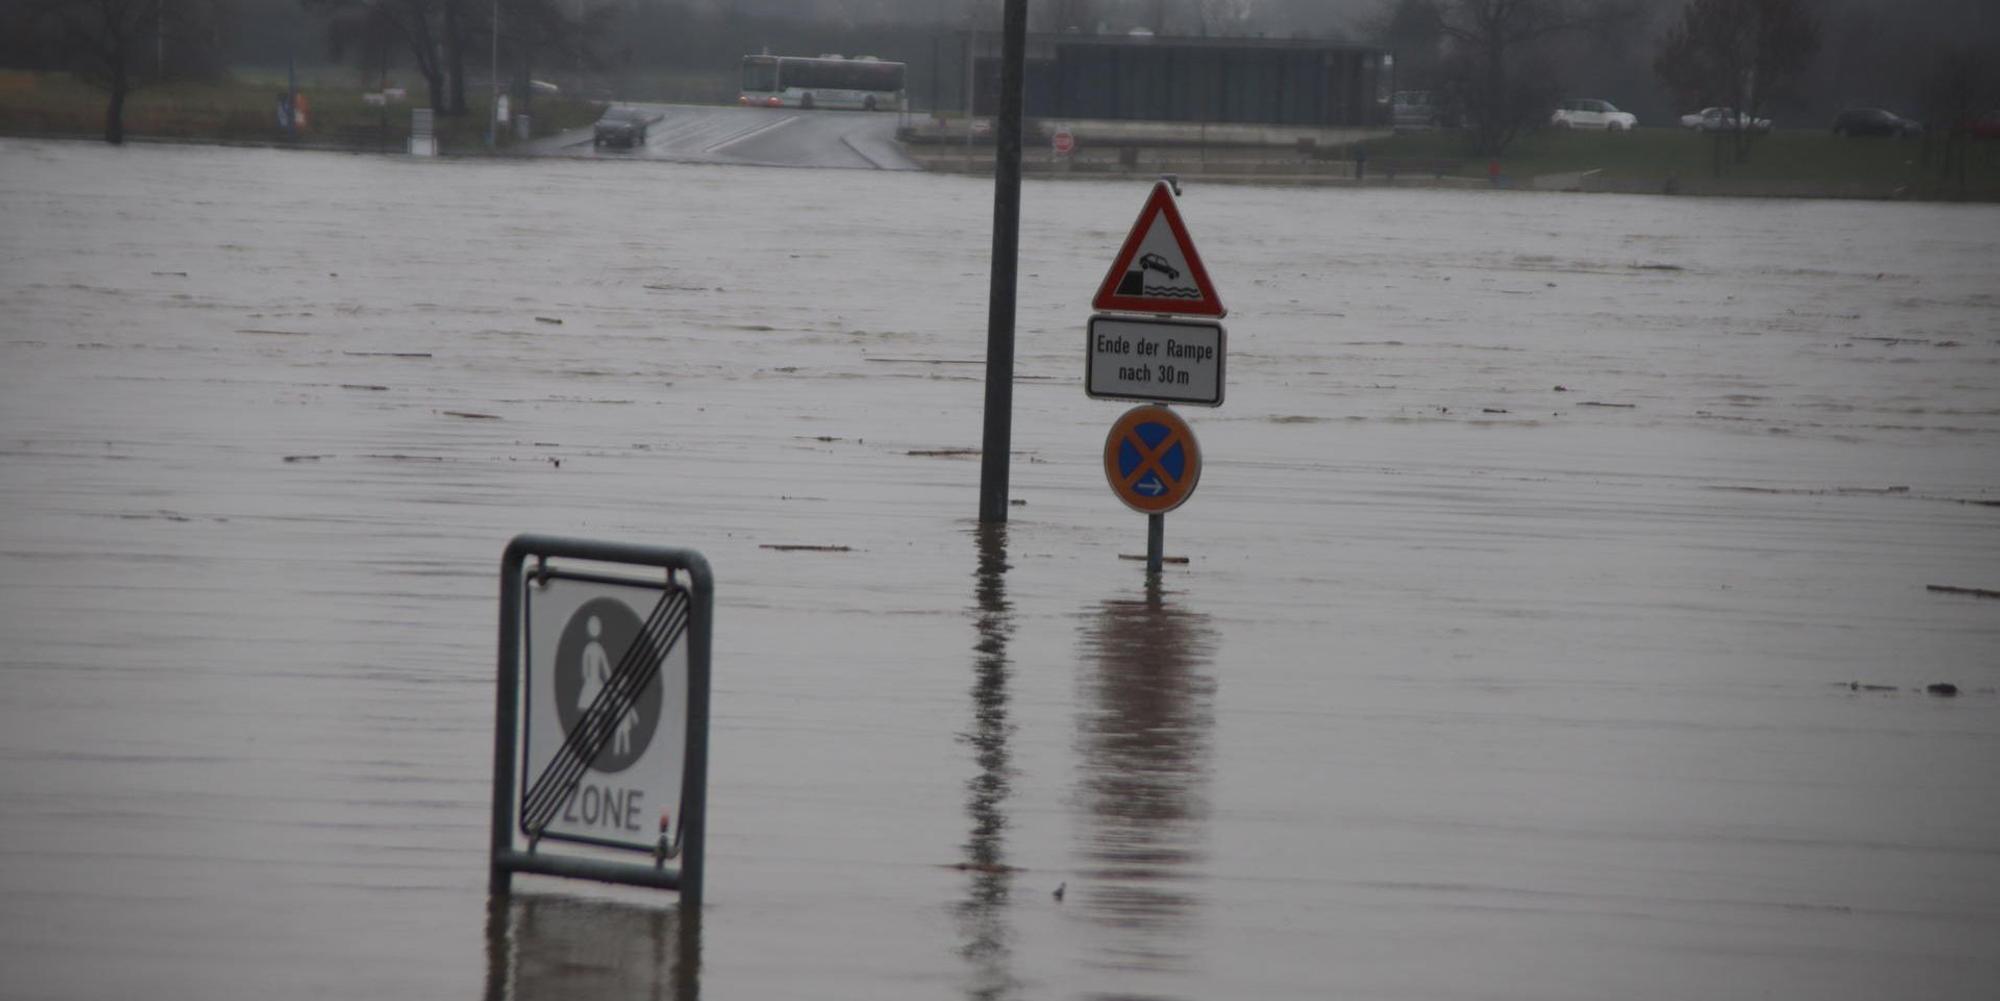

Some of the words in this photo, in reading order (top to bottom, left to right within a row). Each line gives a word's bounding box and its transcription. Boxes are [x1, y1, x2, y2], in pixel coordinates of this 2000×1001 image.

[1097, 334, 1130, 354] Ende
[1137, 337, 1159, 356] der
[1167, 338, 1213, 363] Rampe
[1118, 363, 1151, 382] nach
[562, 780, 645, 832] ZONE
